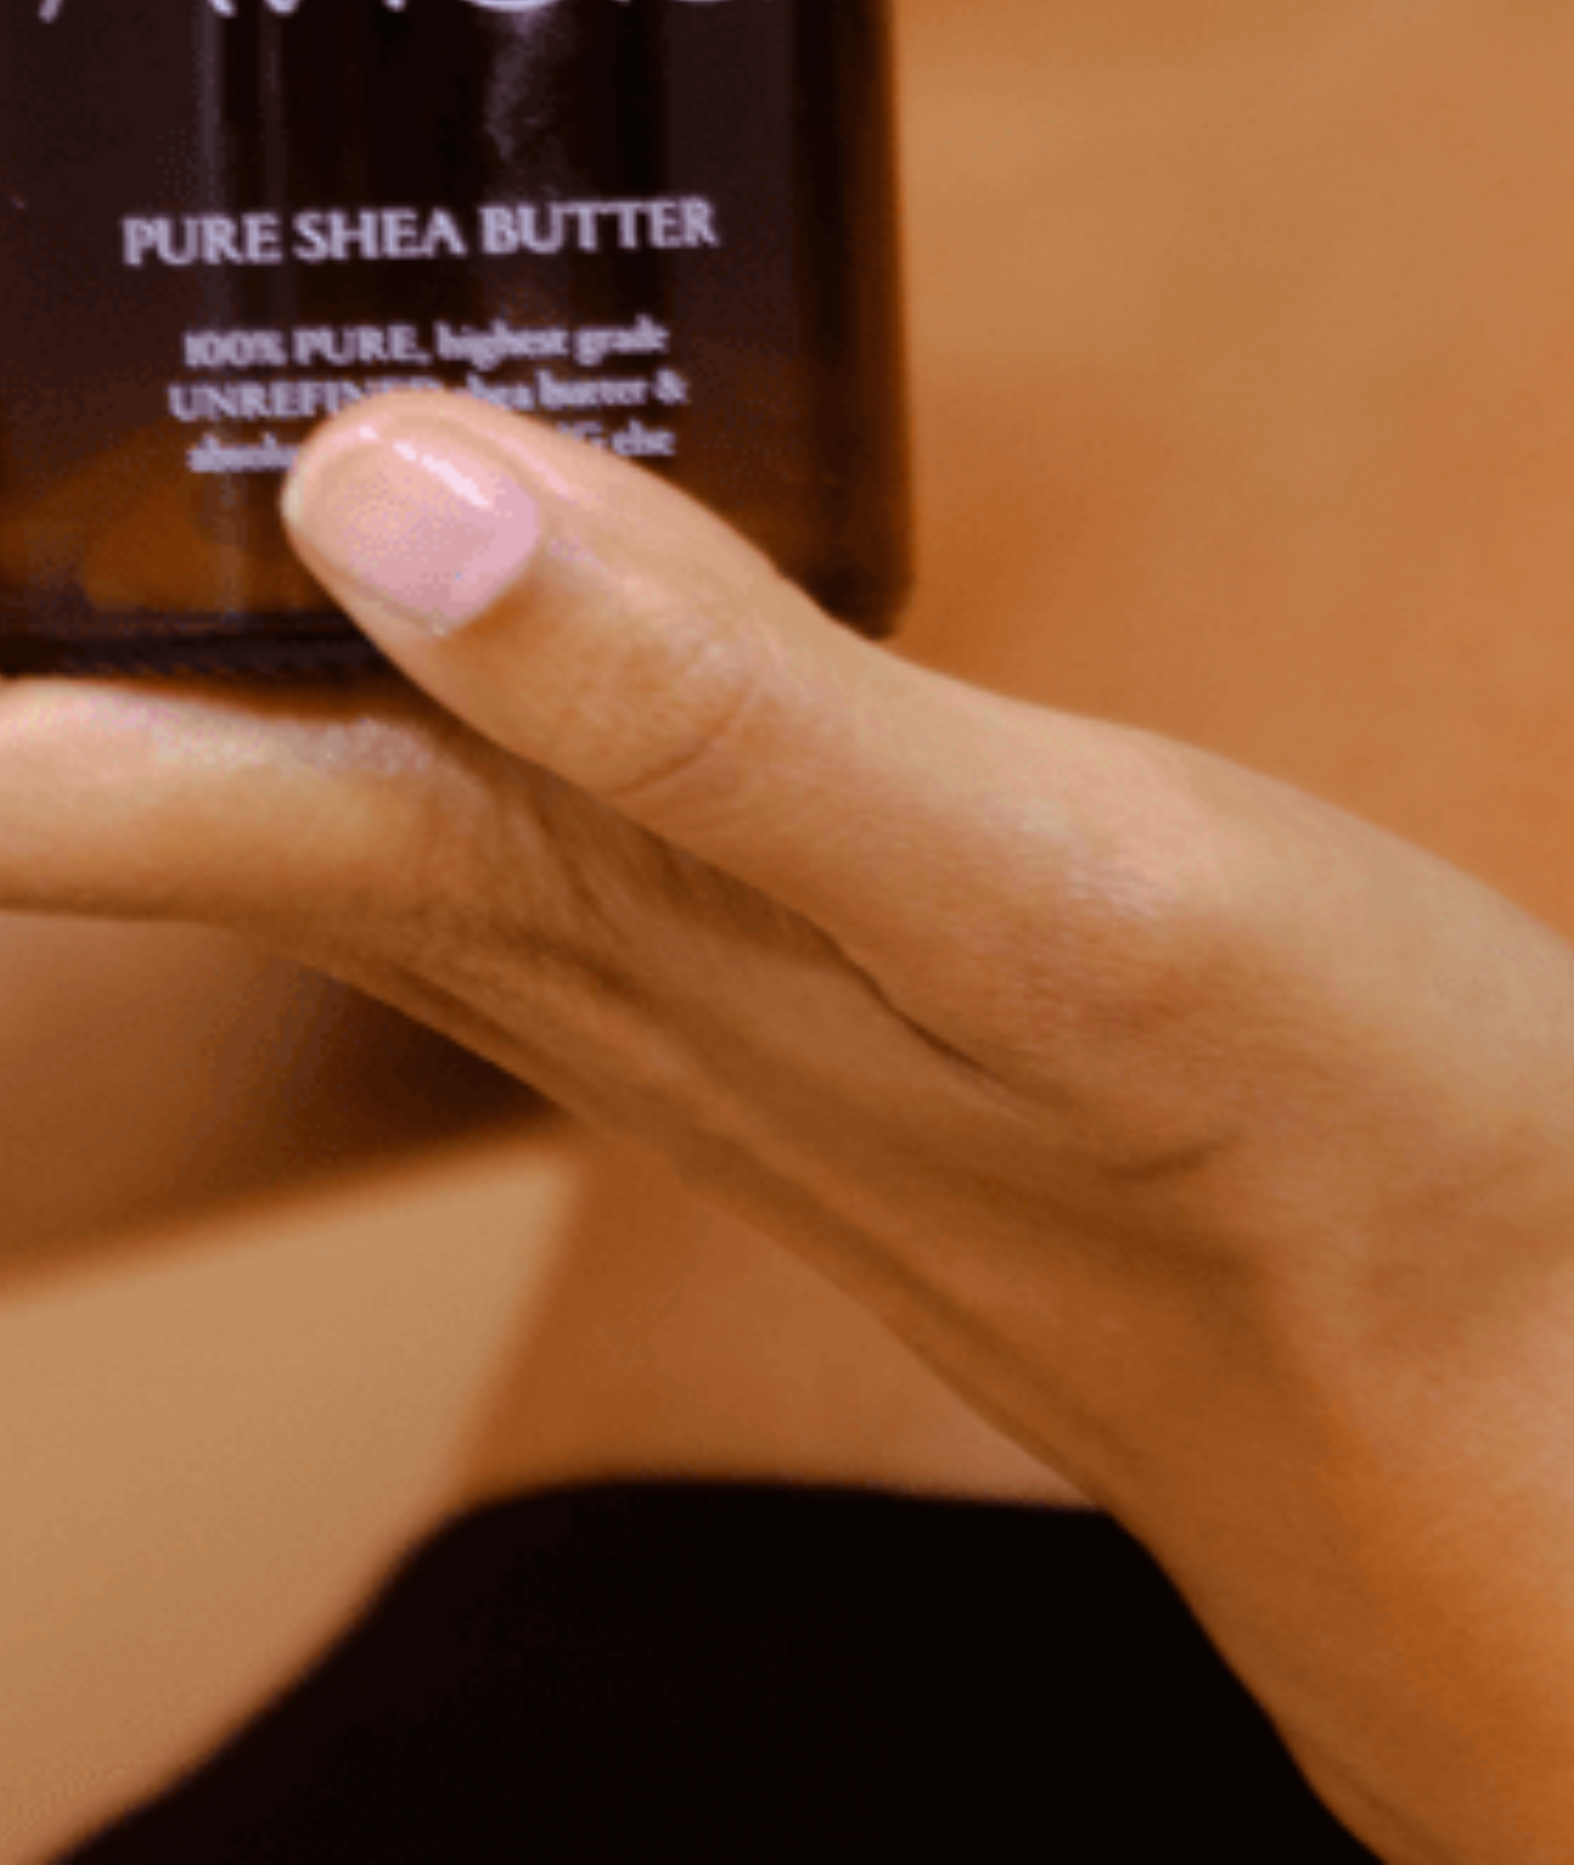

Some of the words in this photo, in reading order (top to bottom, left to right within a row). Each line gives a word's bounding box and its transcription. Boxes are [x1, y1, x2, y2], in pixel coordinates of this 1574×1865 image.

[123, 212, 282, 266] PURE
[294, 207, 467, 260] SHEA
[479, 195, 717, 255] BUTTER
[185, 330, 287, 368] 100%
[435, 319, 569, 371] highest
[575, 313, 669, 366] grade
[453, 372, 535, 411] hea
[537, 368, 646, 410] butter
[653, 368, 689, 403] &
